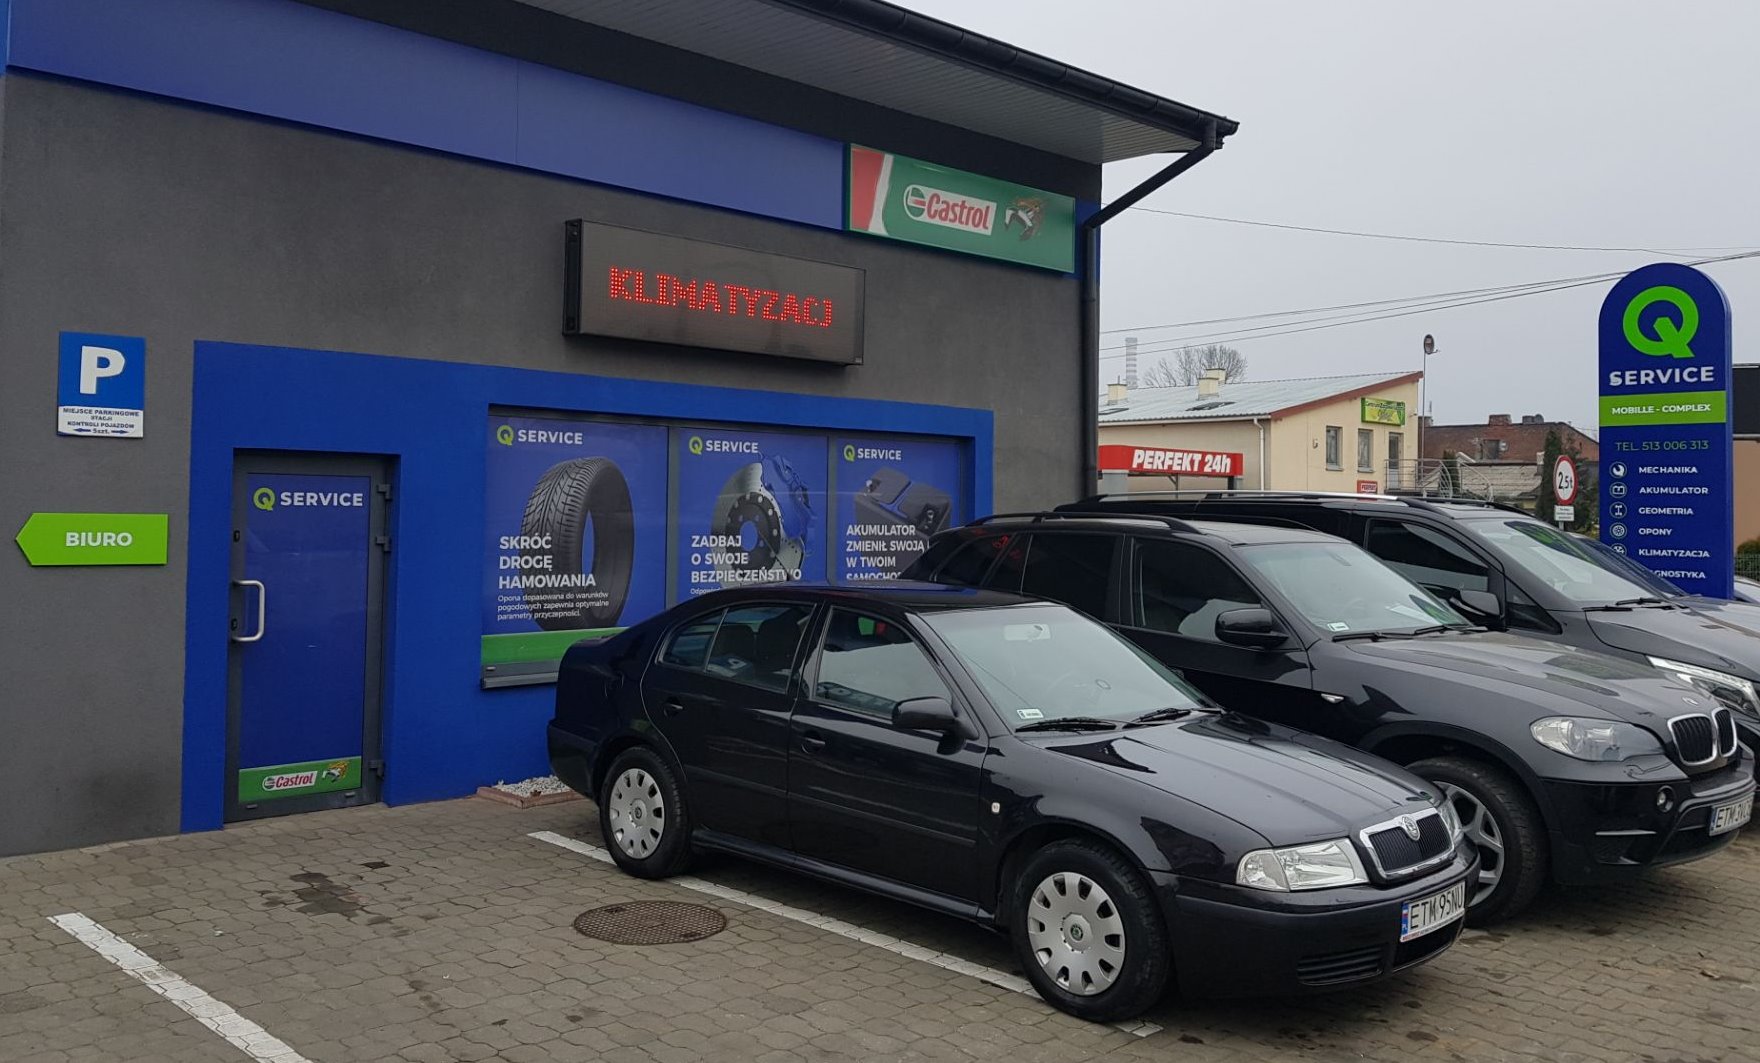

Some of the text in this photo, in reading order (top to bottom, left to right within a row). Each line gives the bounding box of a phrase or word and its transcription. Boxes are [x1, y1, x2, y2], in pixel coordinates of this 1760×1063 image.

[926, 192, 991, 230] Castrol
[610, 265, 832, 327] KLIMATYZACJ
[1622, 286, 1699, 358] Q
[80, 345, 126, 394] P
[1609, 366, 1715, 386] SERVICE
[94, 409, 140, 417] PARKINGOWE
[1611, 406, 1655, 415] MOBILLE
[1661, 403, 1712, 413] COMPLEX
[496, 425, 584, 446] Q SERVICE
[688, 436, 759, 455] Q SERVICE
[1641, 441, 1662, 451] 513
[1663, 440, 1688, 451] 006
[1689, 440, 1709, 450] 313
[843, 444, 902, 462] Q SERVICE
[1131, 449, 1232, 473] PERFEKT 24h
[1638, 466, 1699, 474] MECHANIKA
[1639, 487, 1709, 495] AKUMULATOR
[253, 487, 364, 511] Q SERVICE
[1638, 507, 1694, 515] GEOMETRIA
[846, 524, 916, 536] AKUMULATOR
[1638, 528, 1673, 536] OPONY
[65, 531, 133, 547] BIURO
[499, 532, 552, 549] SKRÓĆ
[691, 535, 742, 548] ZADBAJ
[846, 540, 926, 554] ZMIENIŁ SWOJĄ
[1638, 549, 1711, 558] KLIMATYZACJA
[499, 555, 553, 571] DROGĘ
[691, 552, 749, 565] O SWOJE
[846, 556, 896, 568] W TWOIM
[498, 574, 597, 589] HAMOWANIA
[1650, 570, 1706, 579] GNOSTYKA
[497, 591, 609, 604] Opona dopasowana do warunków
[497, 599, 610, 612] pogodowych zapewnia optymalne
[497, 612, 532, 622] parametry
[275, 772, 314, 789] Castrol
[1410, 884, 1464, 930] ETM 95NU
